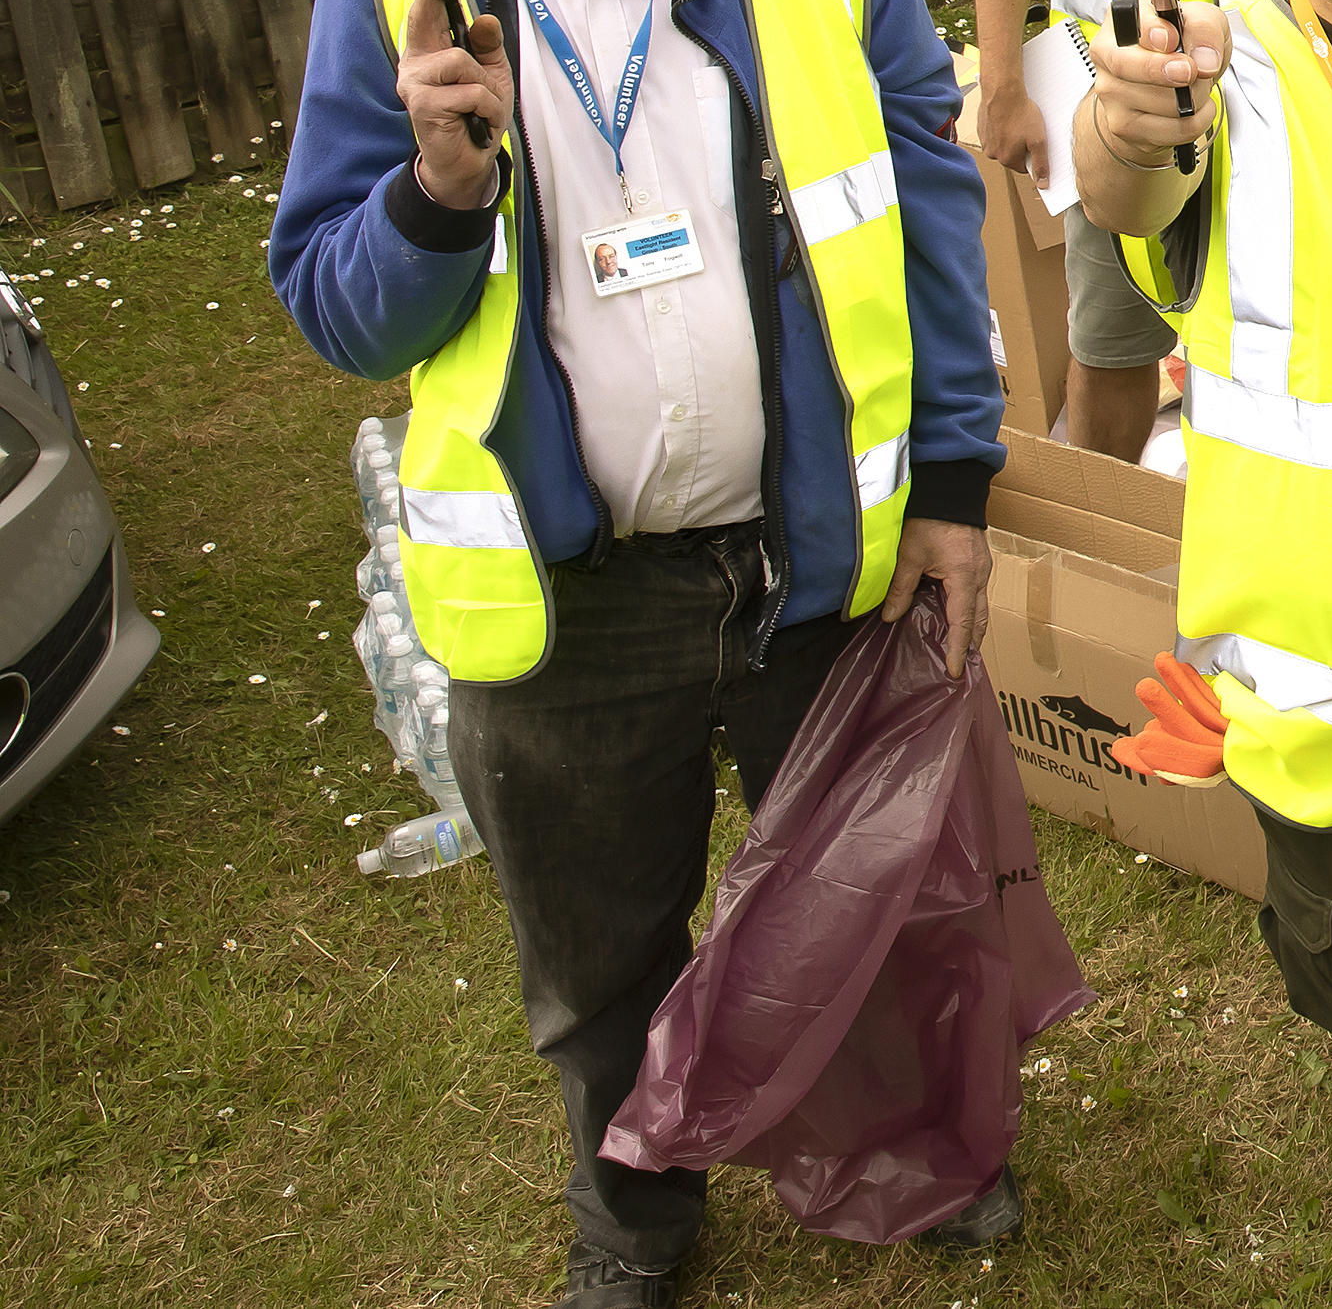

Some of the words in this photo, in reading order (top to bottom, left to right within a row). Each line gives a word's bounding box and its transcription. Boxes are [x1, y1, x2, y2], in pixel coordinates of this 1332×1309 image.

[1304, 20, 1329, 58] Eastlight
[563, 57, 603, 128] Volunteer
[616, 54, 644, 129] Volunteer
